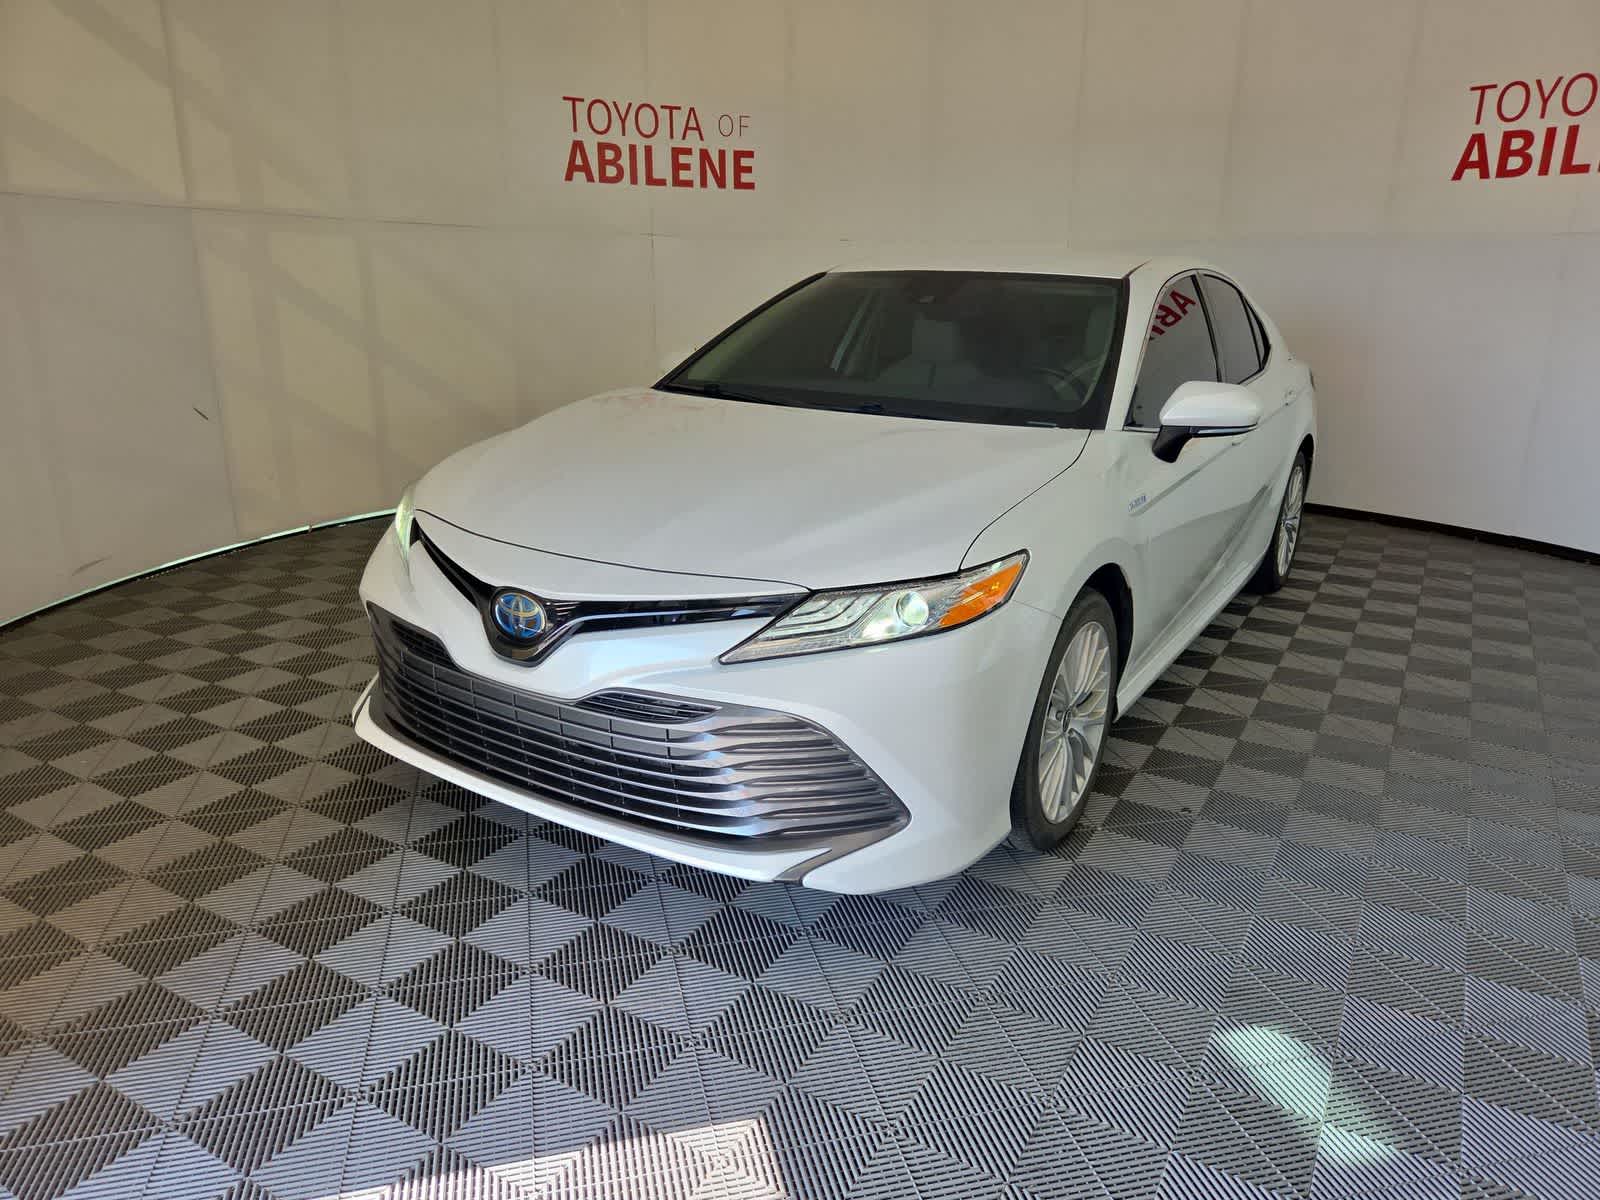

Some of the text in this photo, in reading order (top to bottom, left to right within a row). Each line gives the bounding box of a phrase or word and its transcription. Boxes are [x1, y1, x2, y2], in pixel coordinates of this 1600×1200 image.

[562, 96, 750, 141] TOYOTA OF
[1470, 72, 1599, 125] TOYO
[564, 140, 755, 190] ABILENE
[1450, 124, 1600, 181] ABIL
